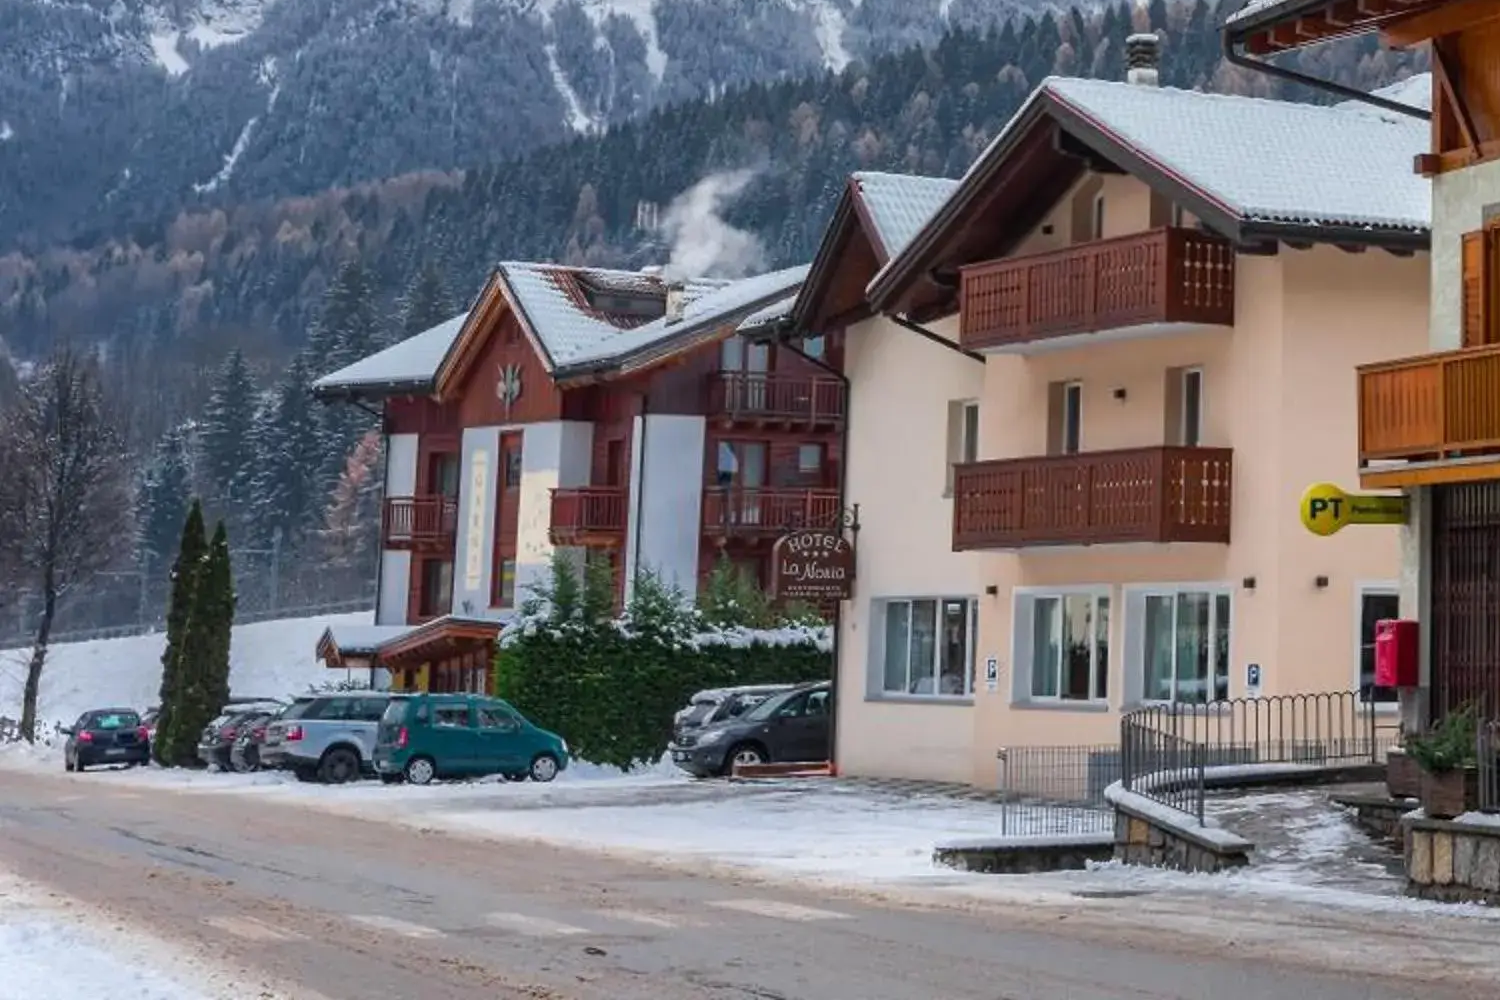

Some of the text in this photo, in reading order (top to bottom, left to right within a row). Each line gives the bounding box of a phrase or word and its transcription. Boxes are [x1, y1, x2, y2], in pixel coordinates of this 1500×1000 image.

[1310, 498, 1343, 519] PT
[787, 533, 845, 553] HOTEL
[783, 560, 799, 575] La
